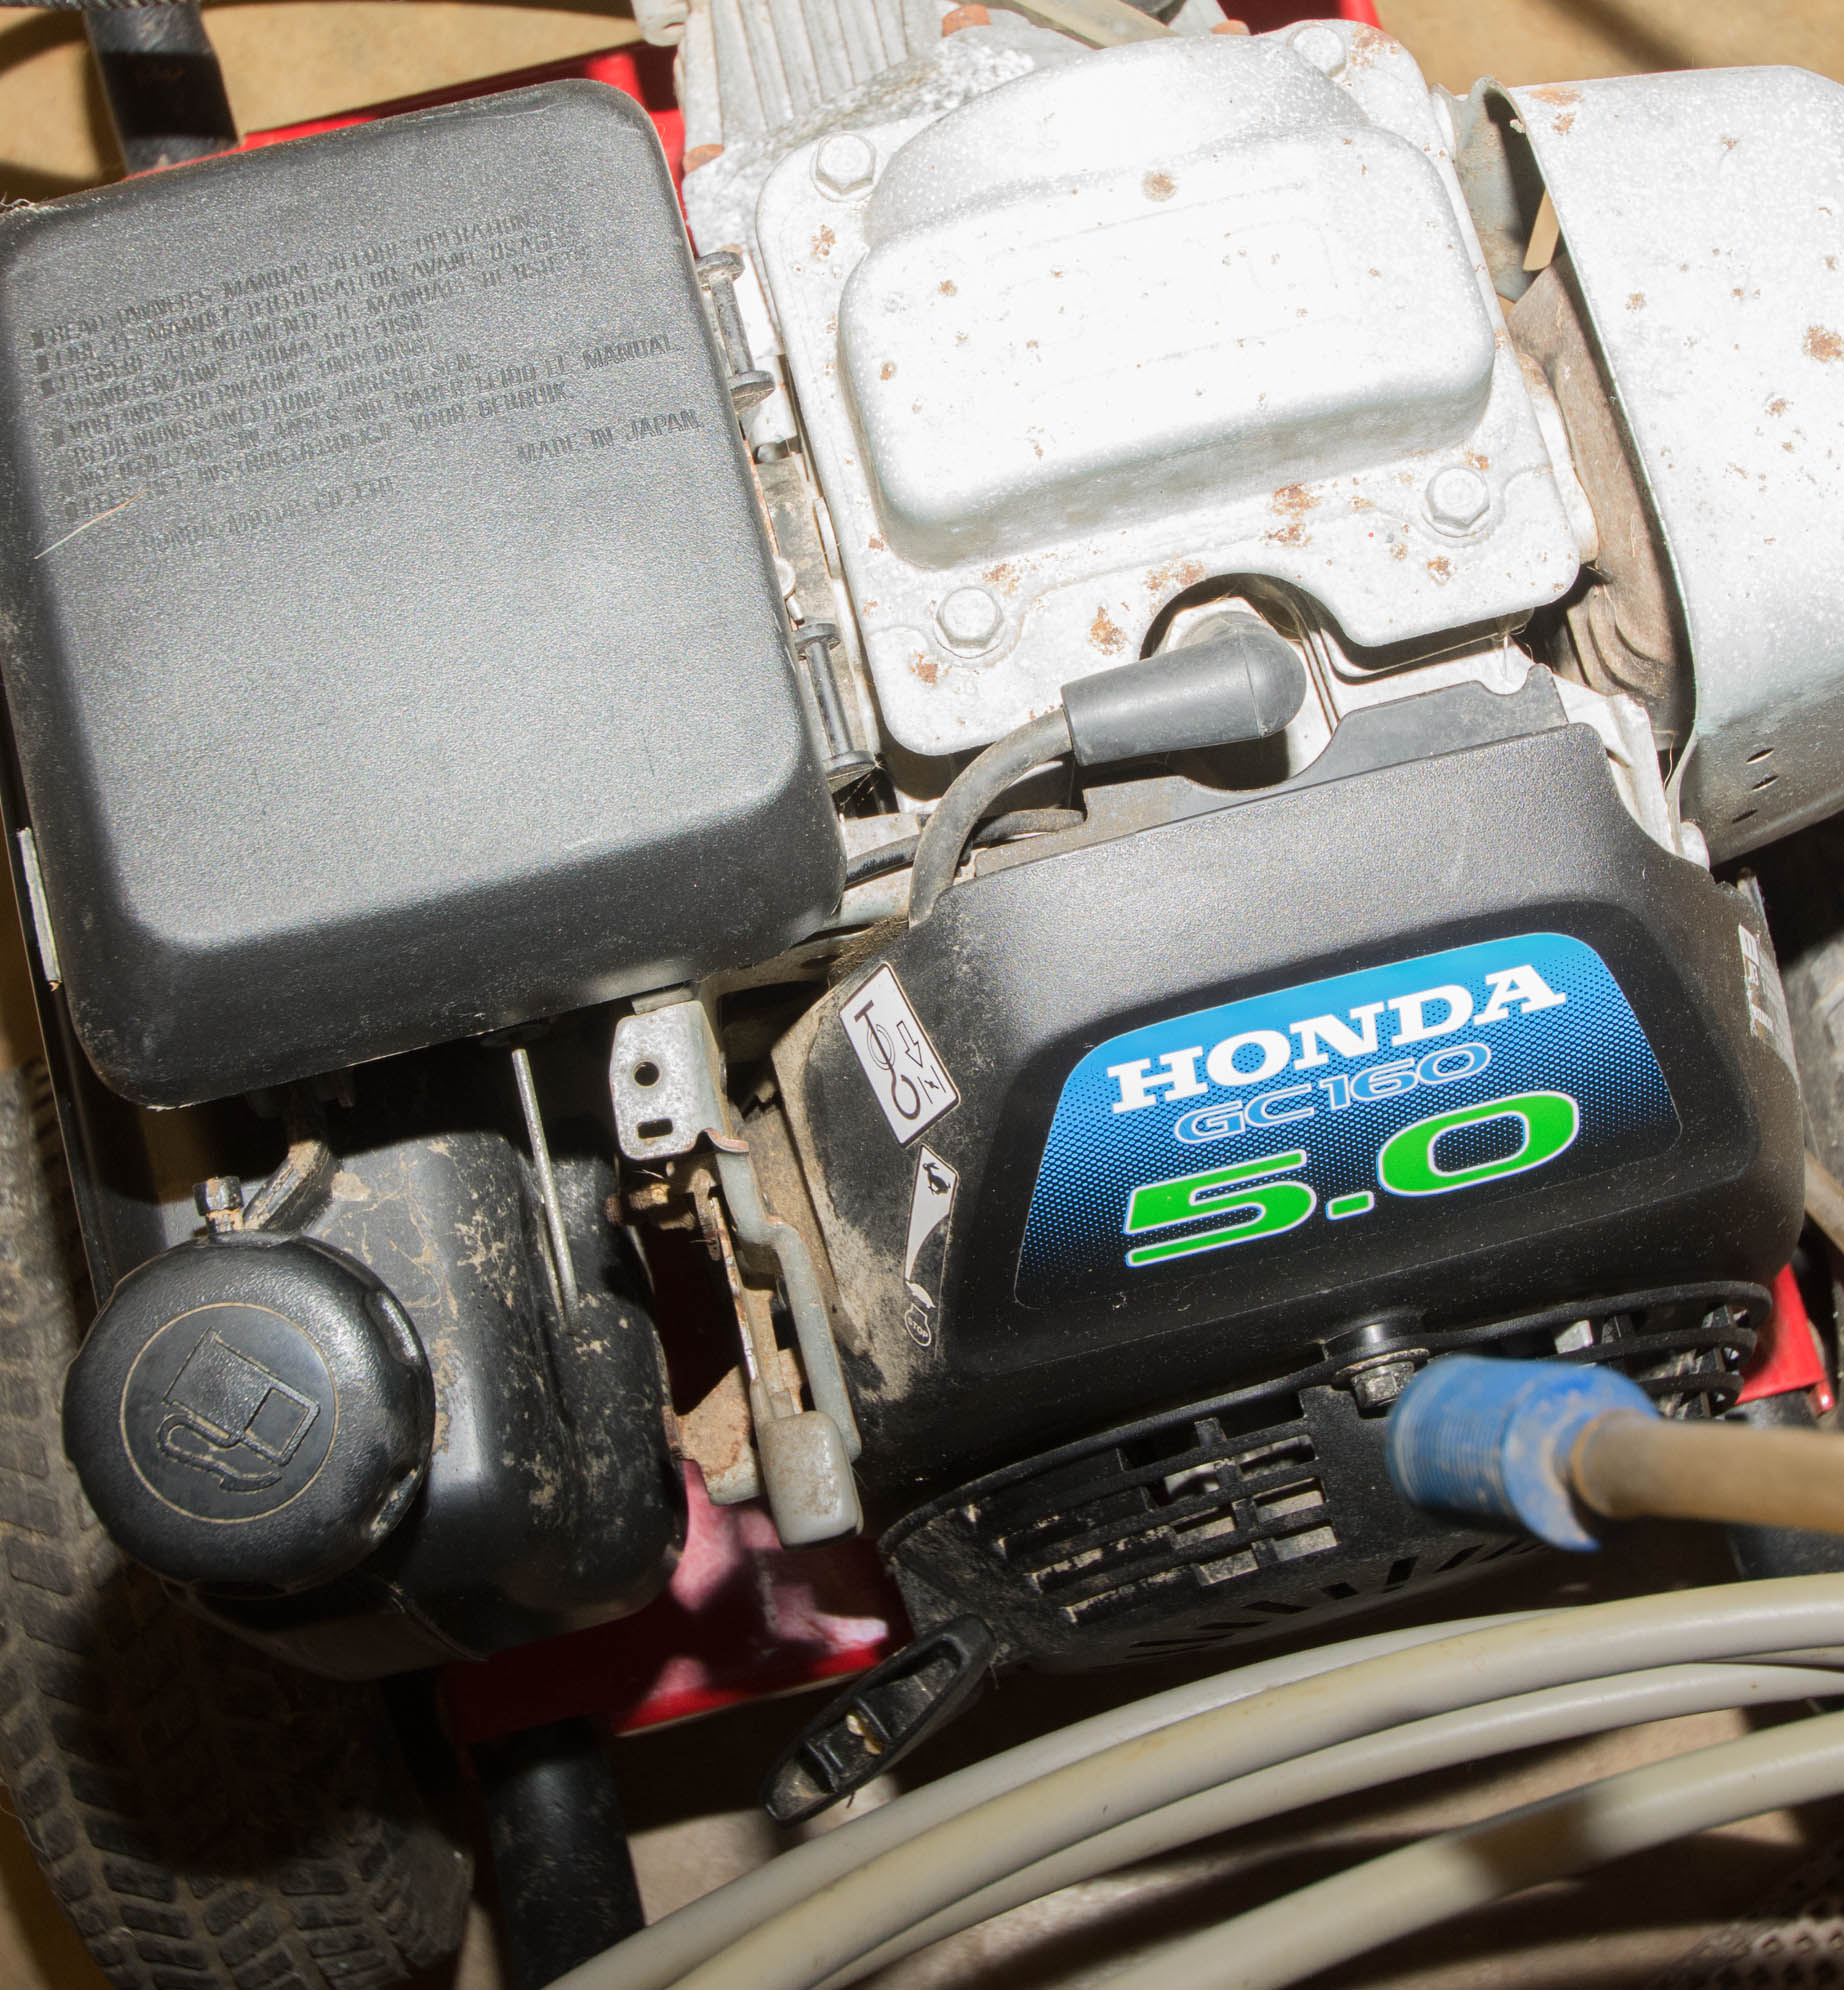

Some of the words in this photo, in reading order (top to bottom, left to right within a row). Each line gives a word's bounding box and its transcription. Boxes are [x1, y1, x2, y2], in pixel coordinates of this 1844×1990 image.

[516, 432, 581, 466] MADE
[589, 425, 616, 450] IN
[1107, 964, 1566, 1114] HONDA
[1175, 1042, 1491, 1144] GC160
[1124, 1091, 1579, 1267] 5.0
[907, 1316, 929, 1338] STOP
